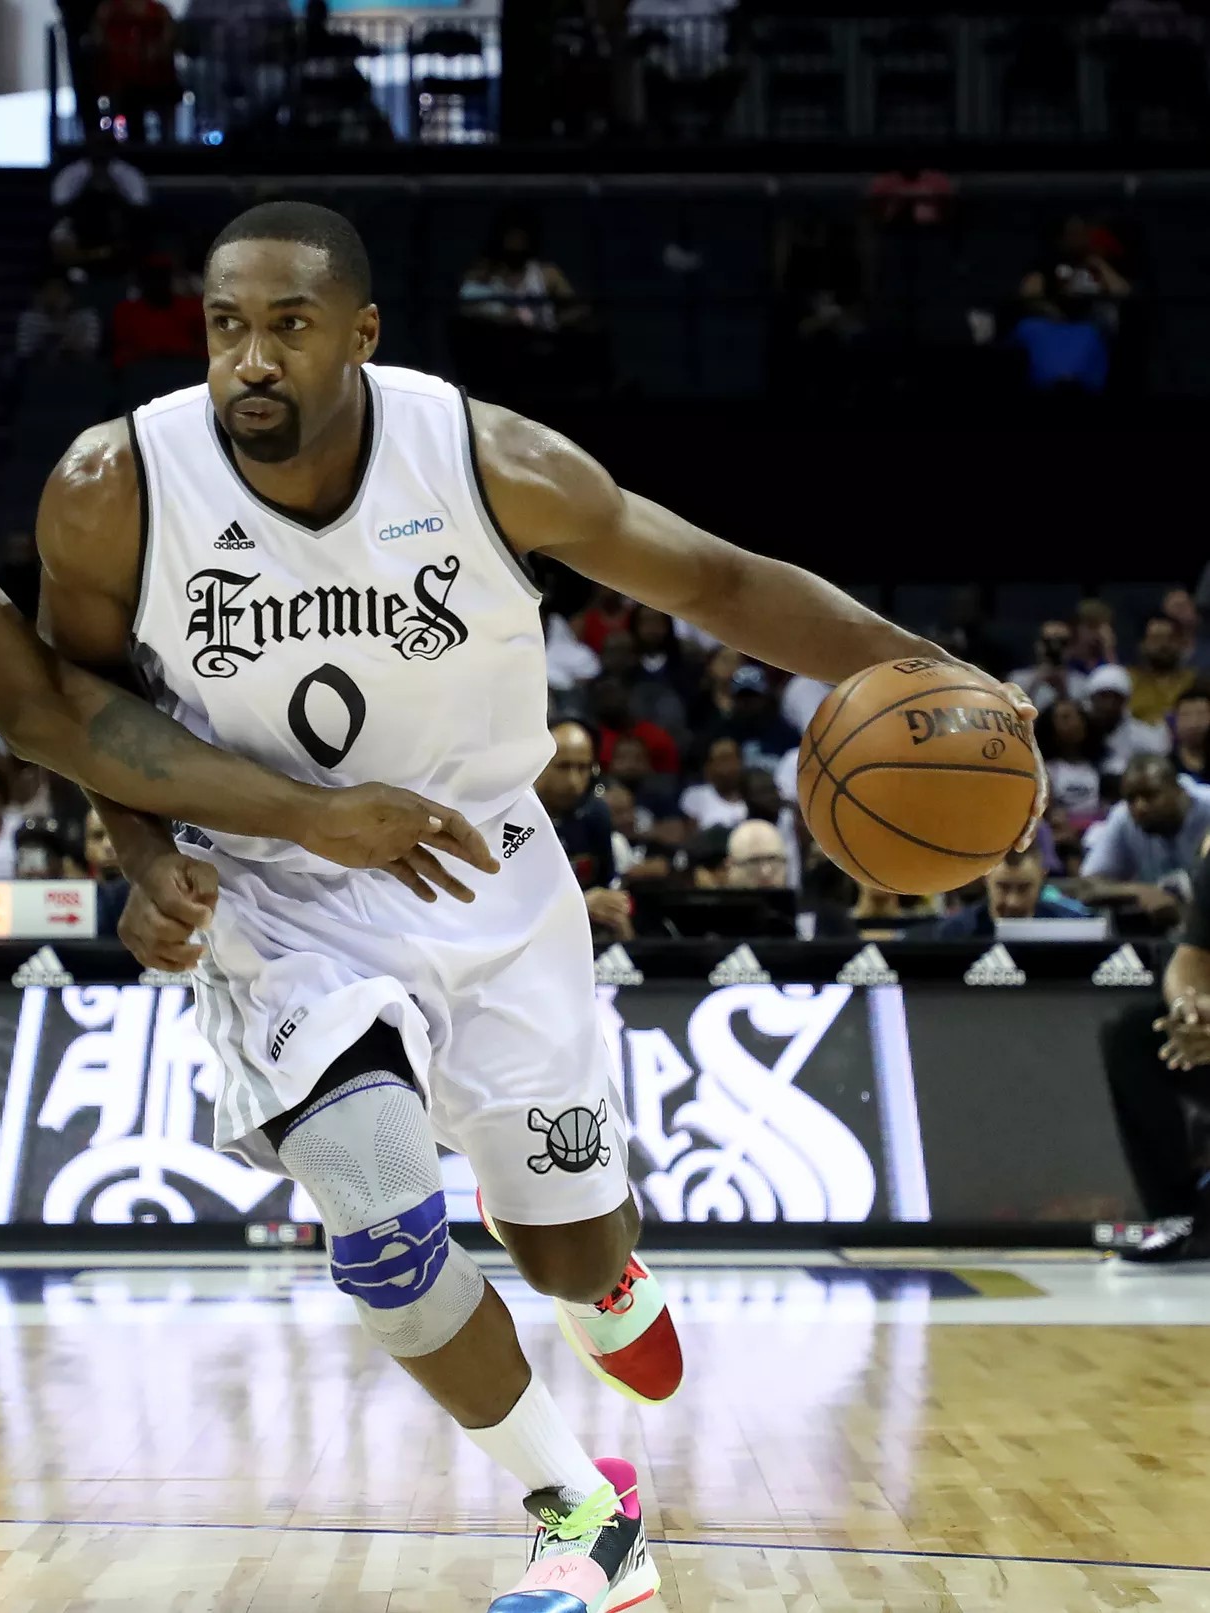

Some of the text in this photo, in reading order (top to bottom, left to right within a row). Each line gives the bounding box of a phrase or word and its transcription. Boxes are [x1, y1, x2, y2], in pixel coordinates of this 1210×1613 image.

[213, 539, 256, 551] adidas
[378, 516, 445, 542] cbdMD
[287, 662, 367, 770] 0
[502, 825, 536, 860] adidas
[270, 1006, 309, 1063] BIG3
